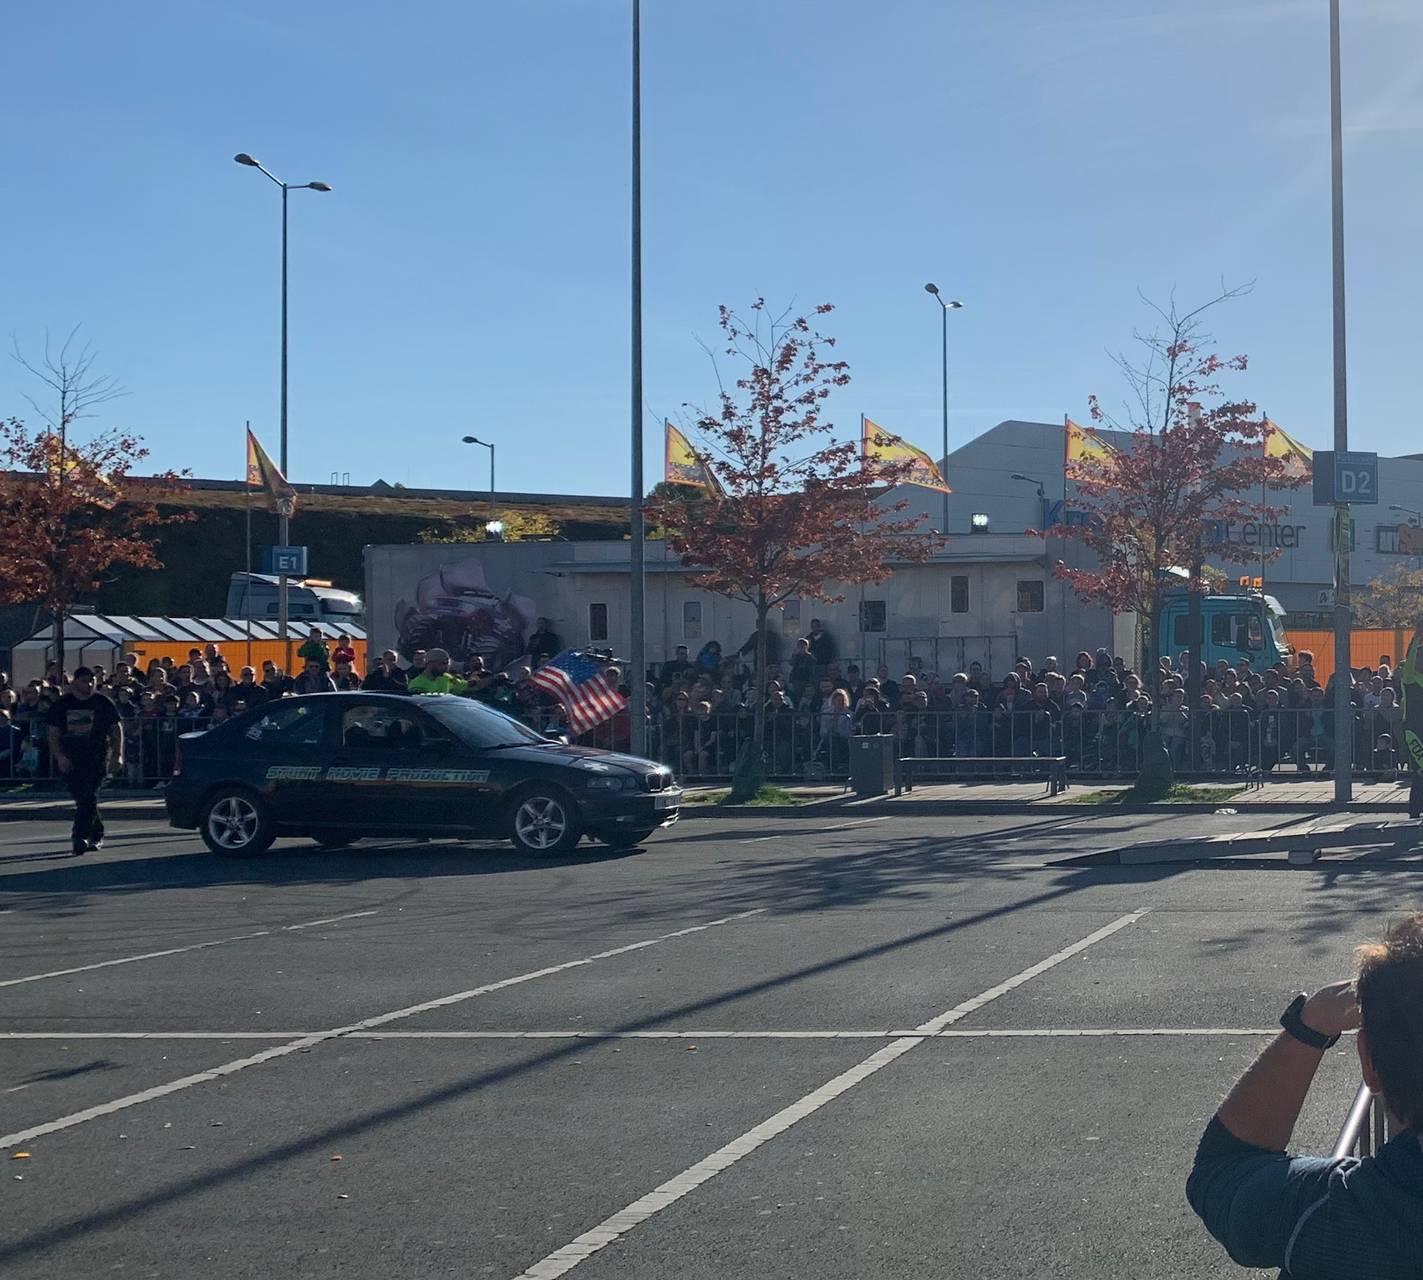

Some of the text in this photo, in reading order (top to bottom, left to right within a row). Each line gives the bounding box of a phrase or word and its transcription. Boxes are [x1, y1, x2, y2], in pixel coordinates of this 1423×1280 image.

[1342, 470, 1371, 493] D2
[279, 556, 297, 569] E1
[266, 766, 490, 783] STUNT MOVIE PRODUCTION
